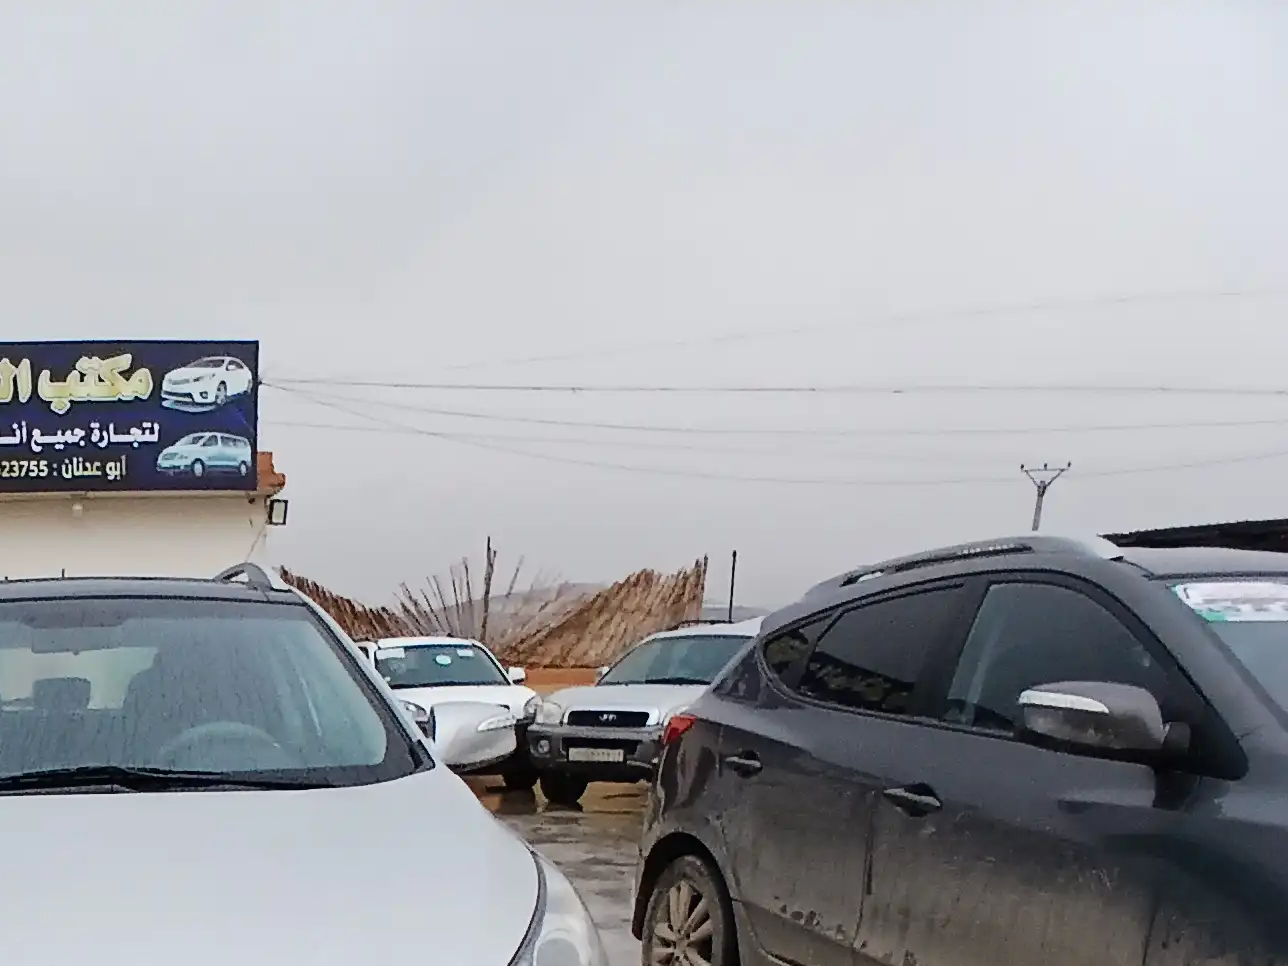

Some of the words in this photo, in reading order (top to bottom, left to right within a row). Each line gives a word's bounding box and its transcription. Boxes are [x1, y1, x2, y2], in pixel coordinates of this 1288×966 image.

[38, 353, 153, 414] مكتب
[31, 427, 86, 452] جميع
[90, 421, 159, 448] لتجارة
[62, 456, 101, 479] عدنان
[105, 454, 127, 480] أبو
